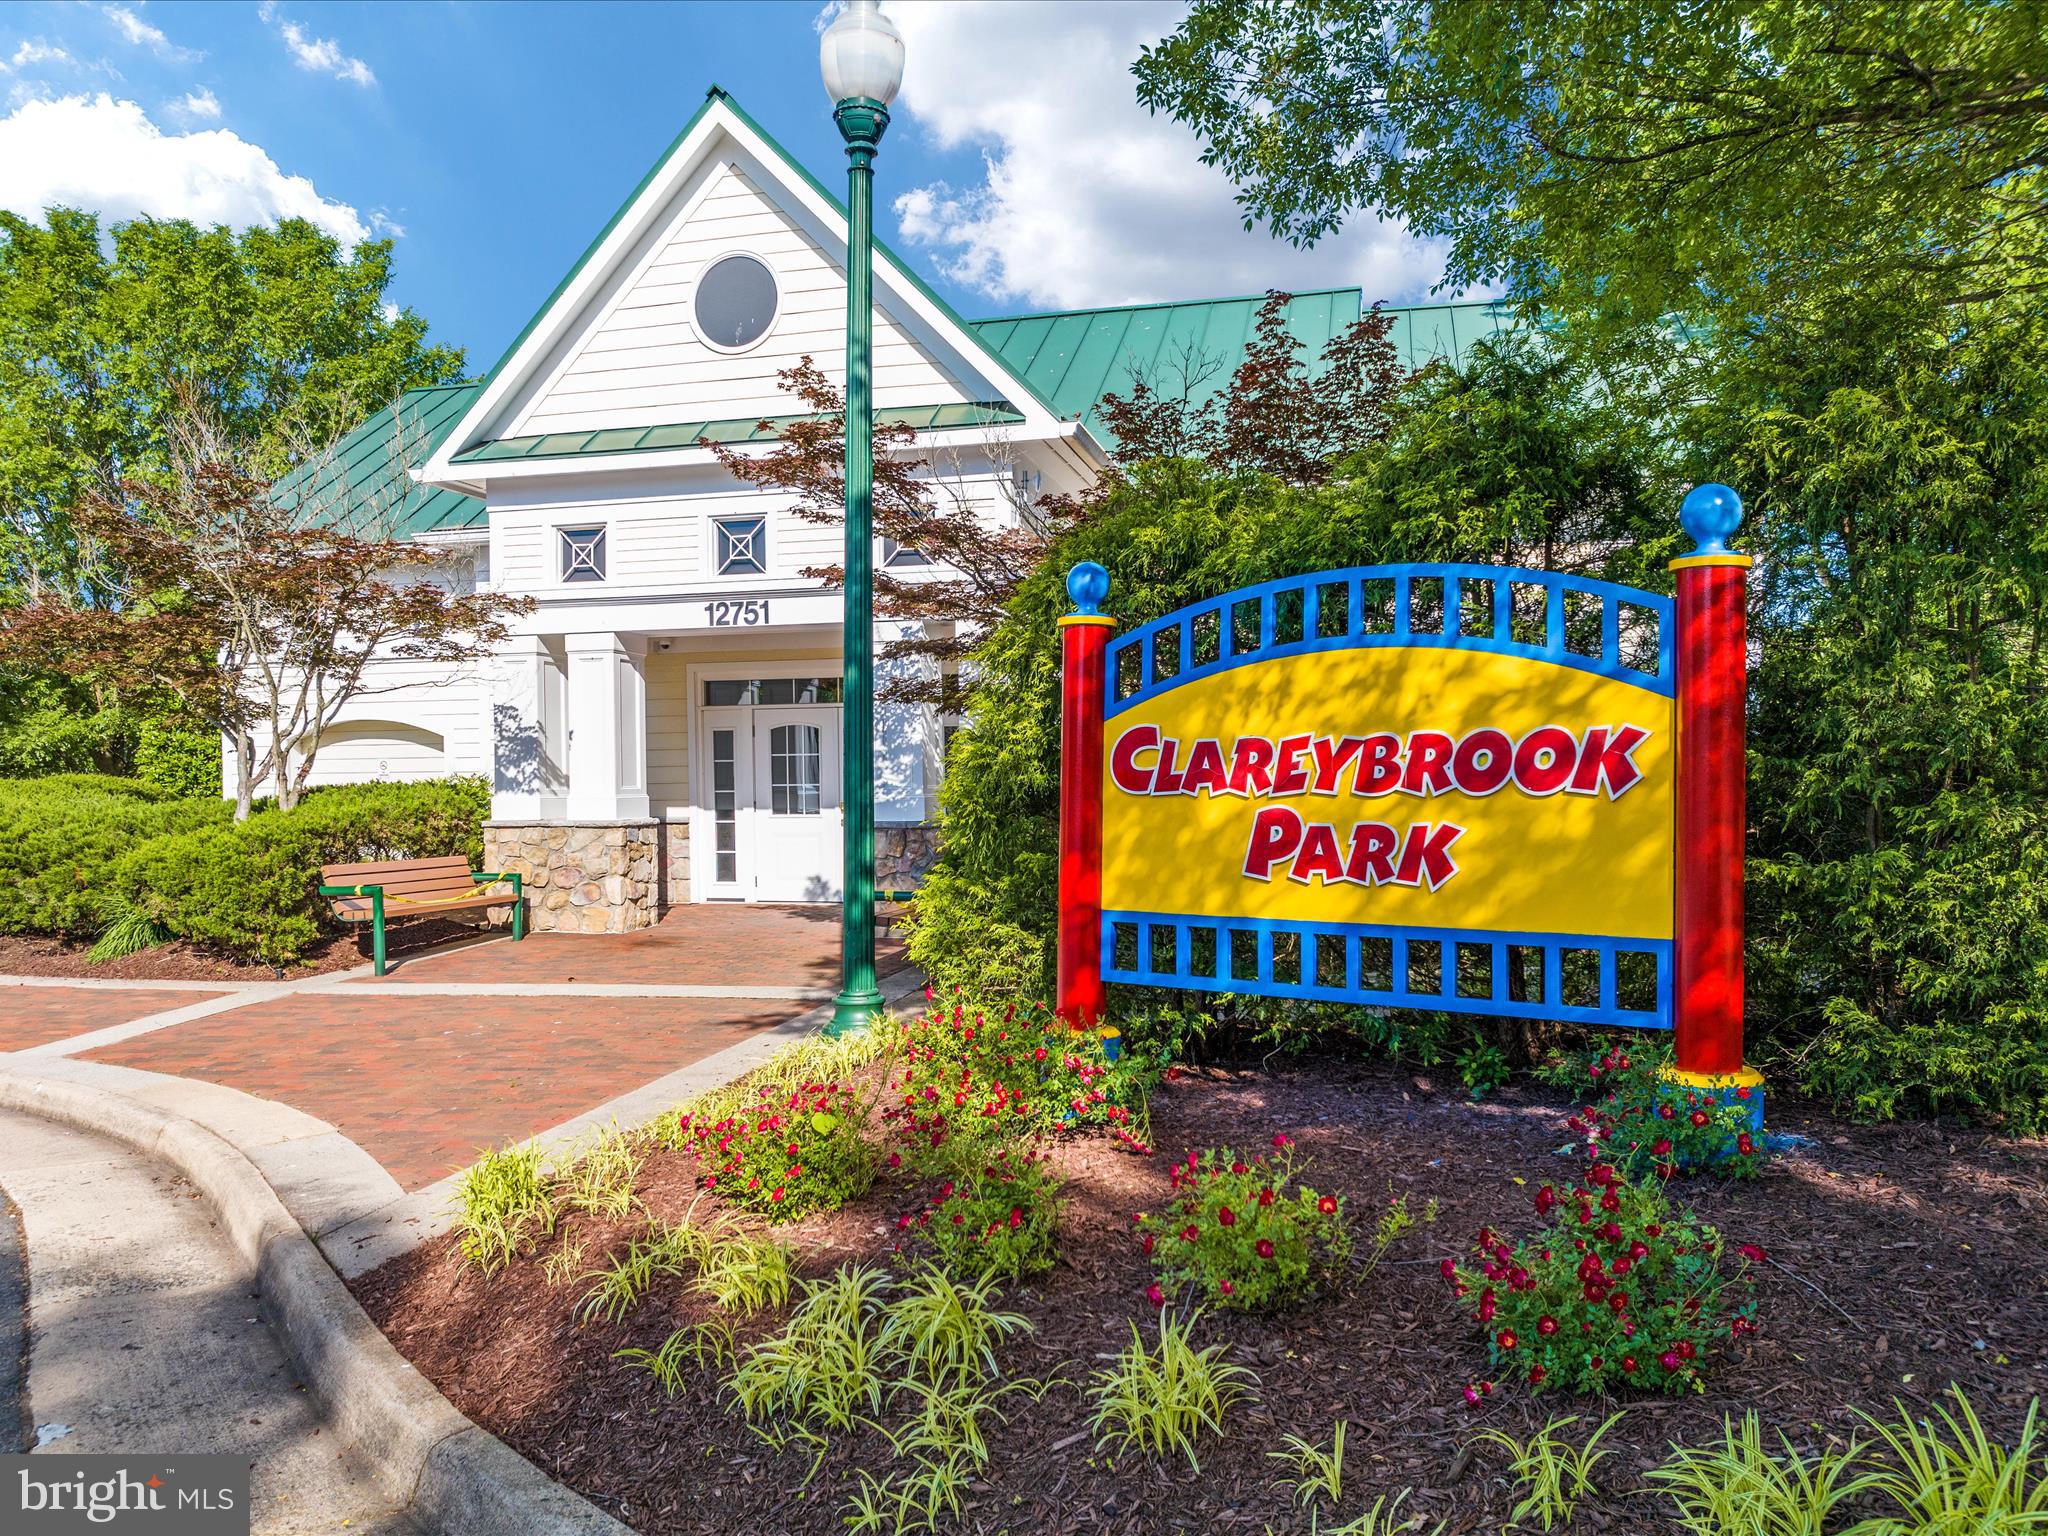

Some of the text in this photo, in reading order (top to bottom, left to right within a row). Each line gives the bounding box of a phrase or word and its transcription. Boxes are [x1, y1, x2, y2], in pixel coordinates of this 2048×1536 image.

[704, 600, 769, 626] 12751
[1109, 722, 1653, 802] CLAREYBROOK
[1242, 804, 1467, 892] PARK
